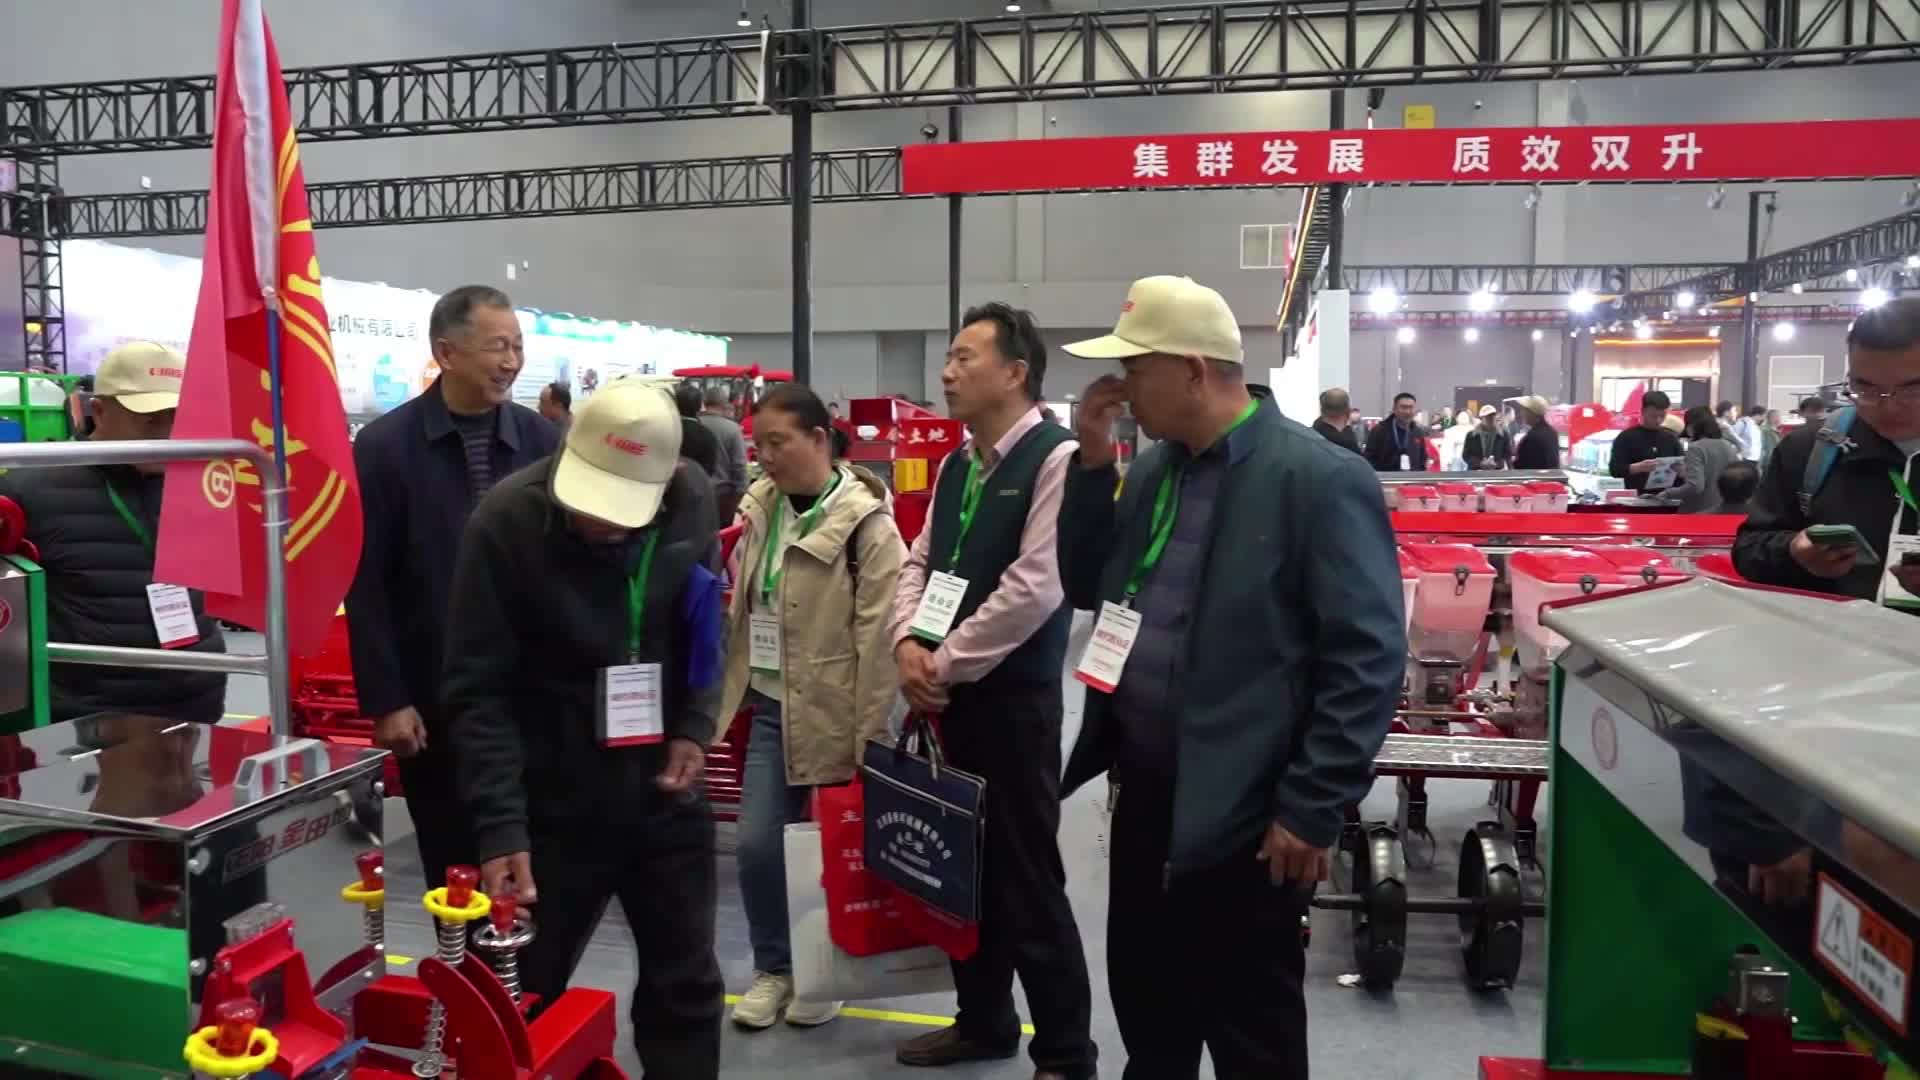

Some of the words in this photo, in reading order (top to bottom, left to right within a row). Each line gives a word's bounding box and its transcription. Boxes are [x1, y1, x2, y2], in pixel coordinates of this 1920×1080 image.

[1133, 138, 1365, 179] 集群发展
[1452, 132, 1704, 174] 质效双升
